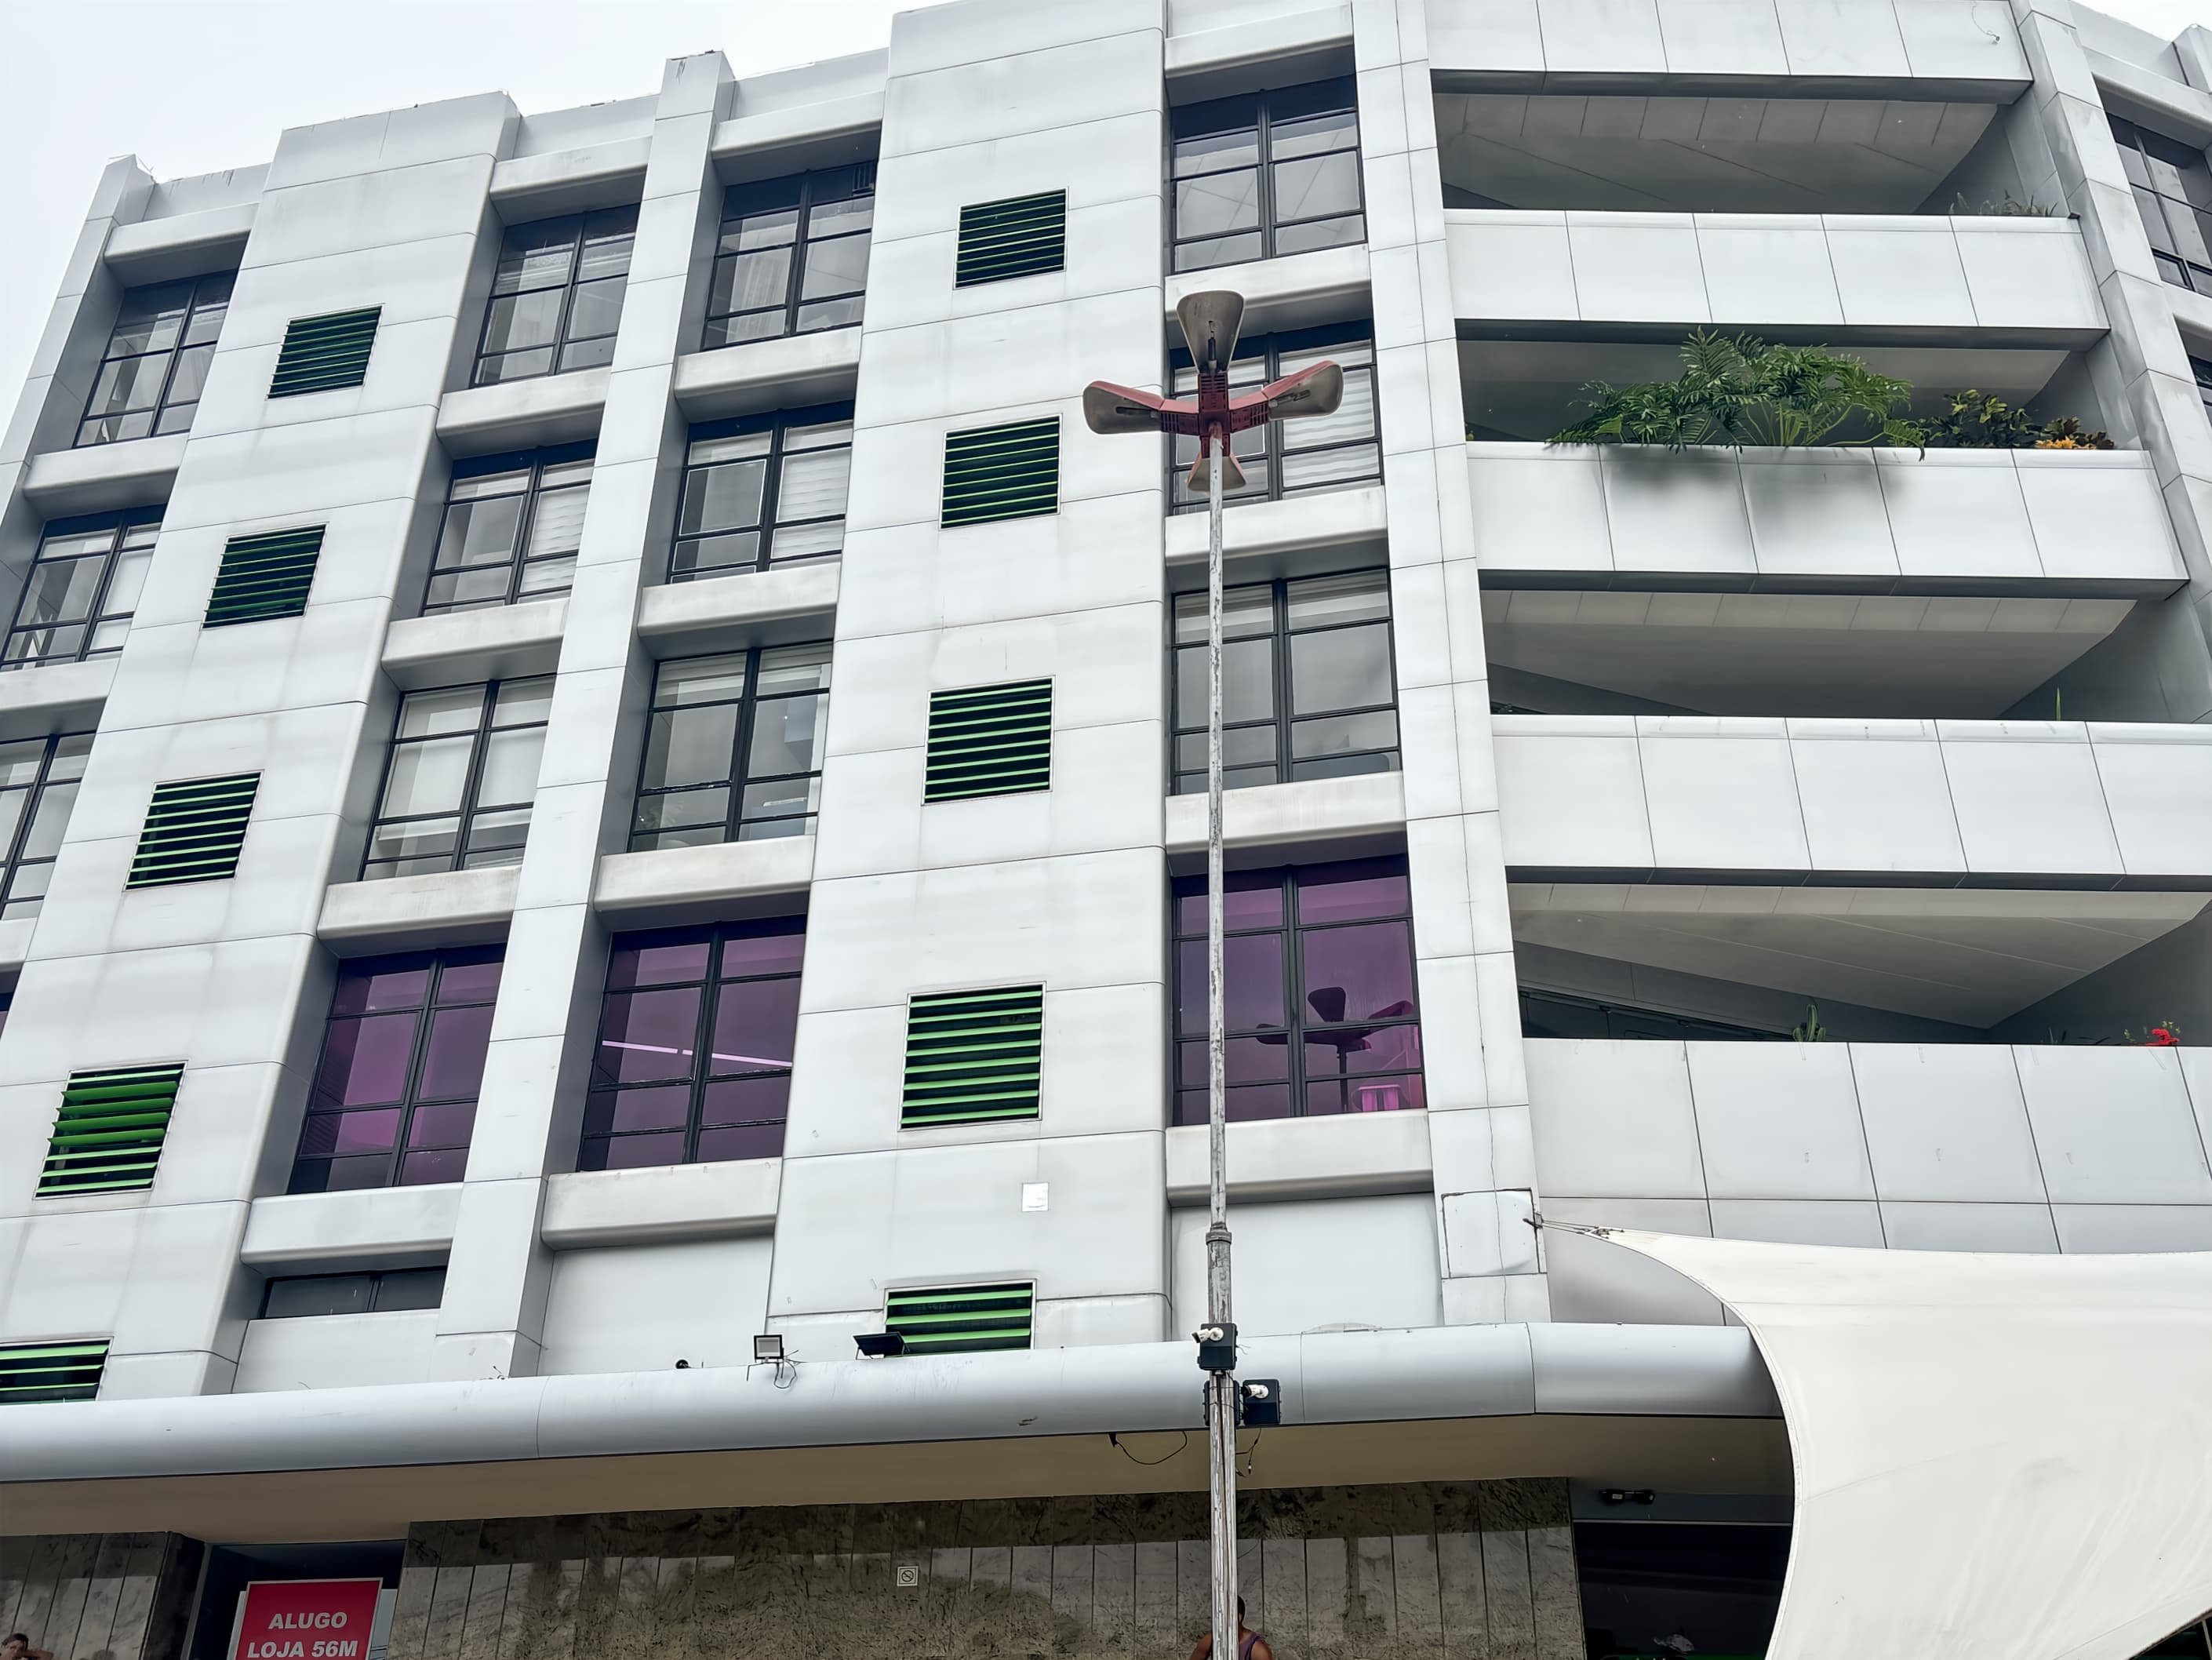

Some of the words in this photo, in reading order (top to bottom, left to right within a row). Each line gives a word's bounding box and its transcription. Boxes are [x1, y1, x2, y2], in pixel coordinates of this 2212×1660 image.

[268, 1612, 347, 1629] ALUGO
[247, 1641, 304, 1658] LOJA
[311, 1640, 358, 1657] 56M
